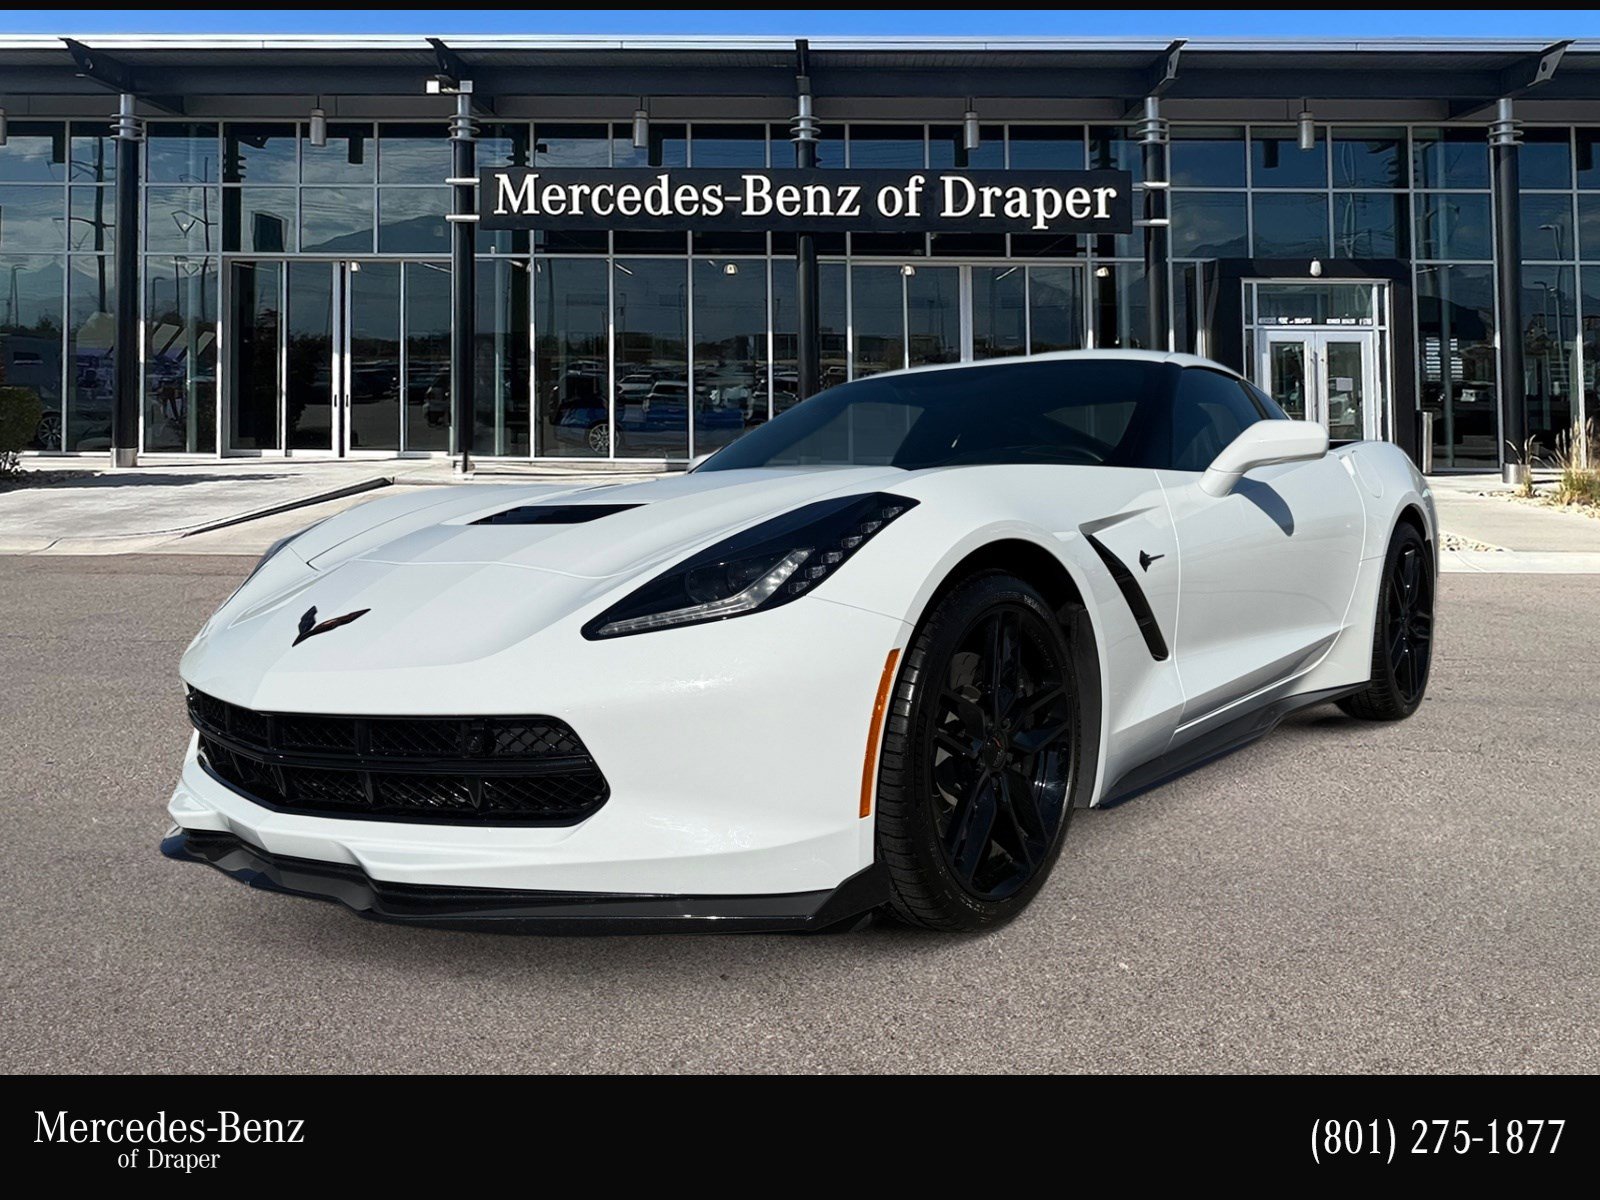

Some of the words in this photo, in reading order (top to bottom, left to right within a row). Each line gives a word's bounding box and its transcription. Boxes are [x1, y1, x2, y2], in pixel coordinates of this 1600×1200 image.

[494, 174, 861, 217] Mercedes-Benz
[877, 175, 926, 218] of
[939, 175, 1117, 230] Draper
